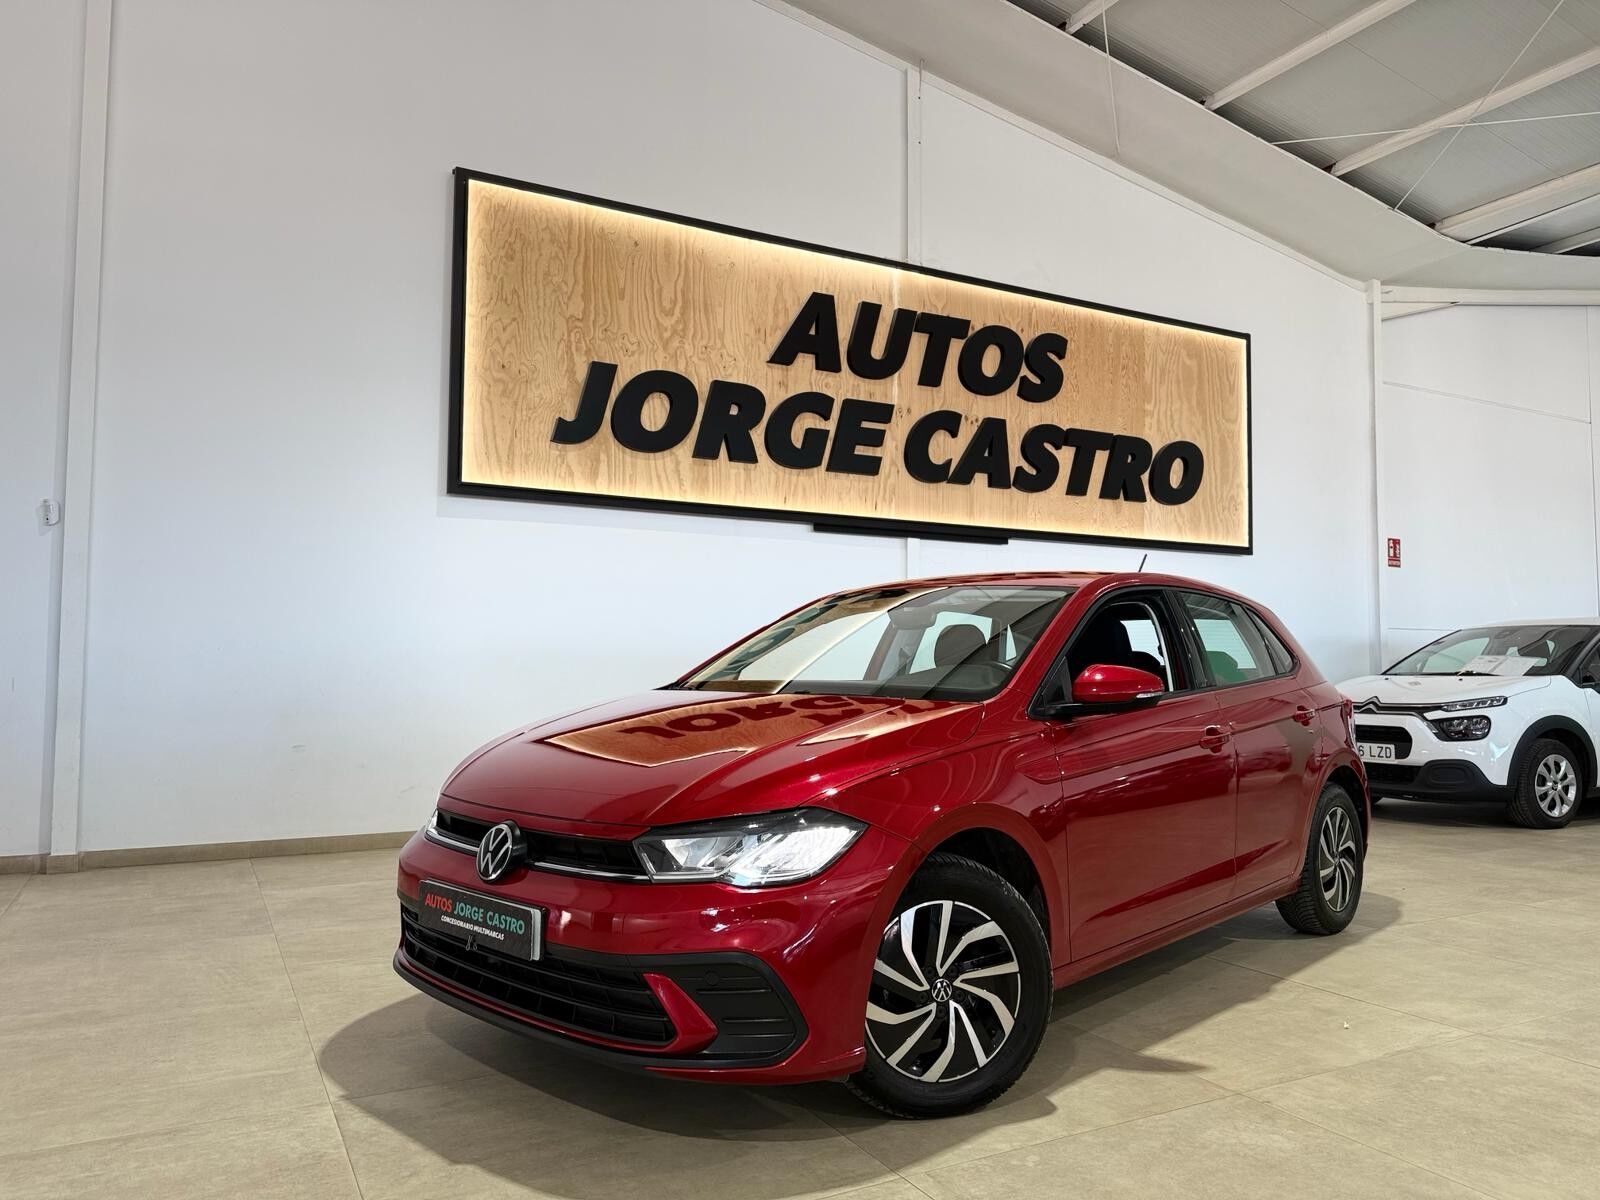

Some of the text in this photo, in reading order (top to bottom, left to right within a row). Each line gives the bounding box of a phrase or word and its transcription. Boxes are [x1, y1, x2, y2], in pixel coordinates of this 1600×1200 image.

[767, 292, 1068, 403] AUTOS
[551, 360, 1204, 505] JORGE CASTRO
[1369, 745, 1392, 758] LZD
[425, 893, 525, 934] AUTOS JORGE CASTRO
[441, 915, 505, 940] CONCESIONARIO MULTIMARCAS
